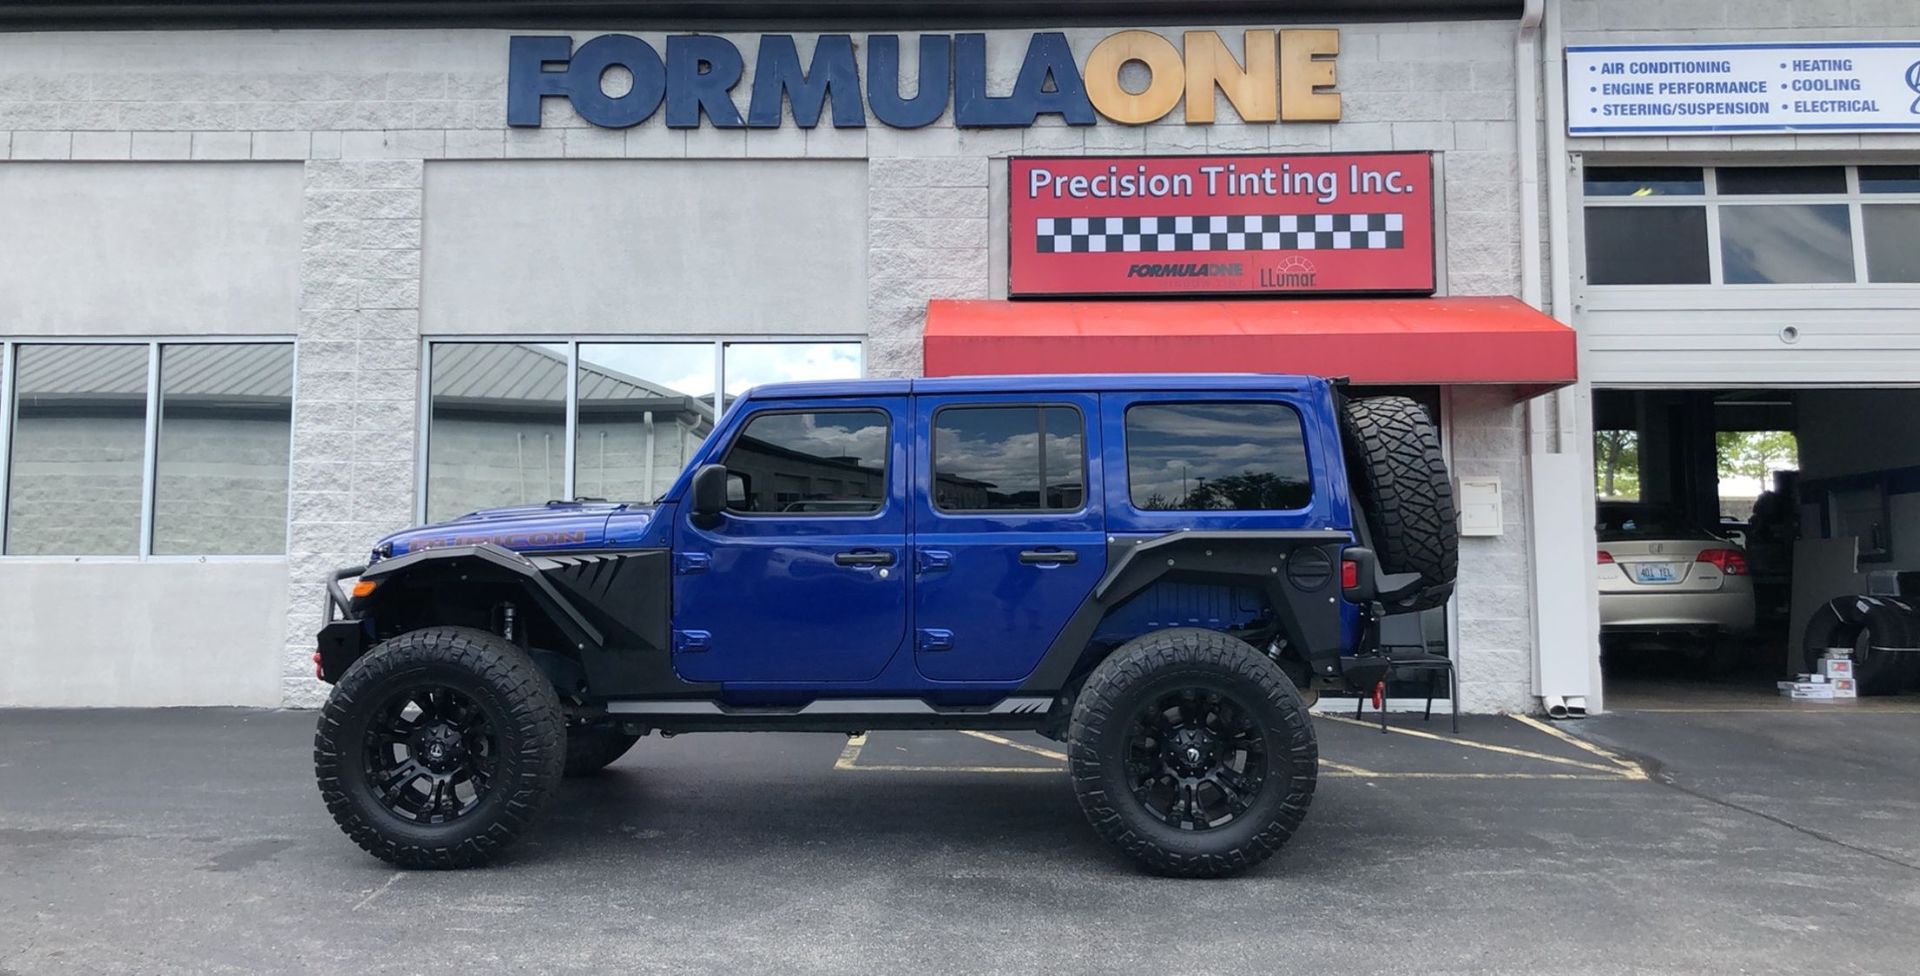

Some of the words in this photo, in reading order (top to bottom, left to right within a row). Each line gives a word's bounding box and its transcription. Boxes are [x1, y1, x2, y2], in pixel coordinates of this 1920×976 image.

[1601, 62, 1625, 75] AIR
[1629, 60, 1731, 75] CONDITIONING
[1792, 59, 1853, 73] HEATING
[1602, 82, 1654, 96] ENGINE
[1658, 80, 1767, 95] PERFORMANCE
[1792, 78, 1861, 92] COOLING
[1603, 101, 1770, 116] STEERING/SUSPENSION
[1794, 99, 1880, 113] ELECTRICAL
[1029, 165, 1193, 199] Precision
[1200, 163, 1338, 204] Tinting
[1350, 164, 1414, 194] Inc.
[408, 530, 586, 552] RUBICON
